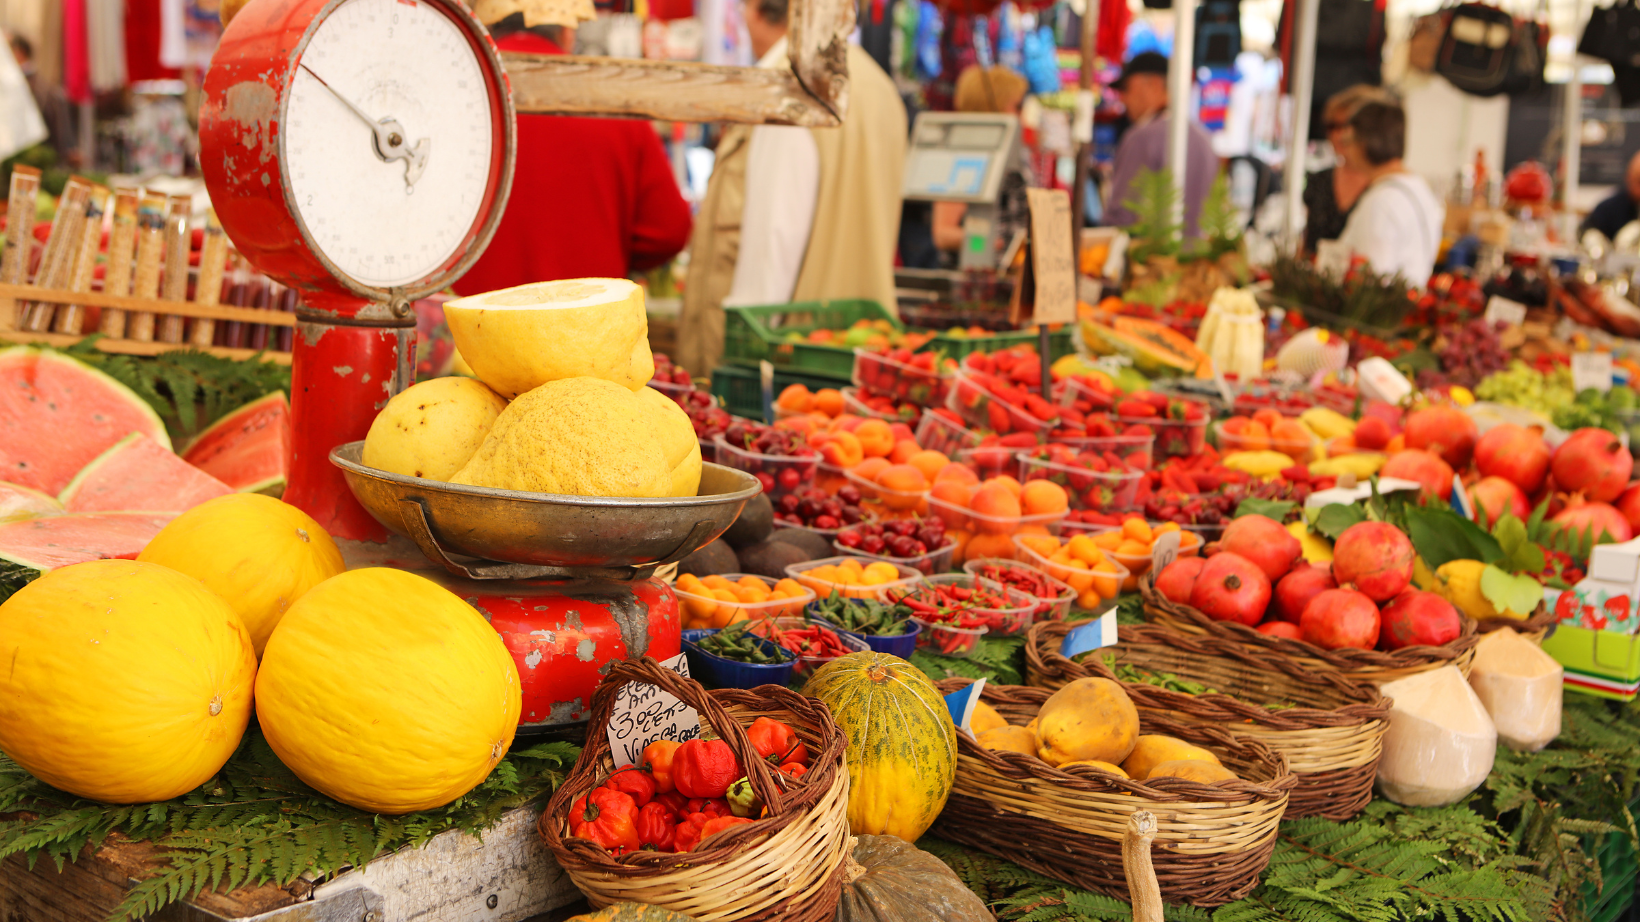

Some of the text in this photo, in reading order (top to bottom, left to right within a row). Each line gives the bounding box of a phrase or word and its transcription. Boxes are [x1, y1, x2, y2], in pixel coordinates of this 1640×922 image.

[392, 13, 399, 26] 0
[387, 26, 394, 40] 3
[306, 194, 313, 207] 2
